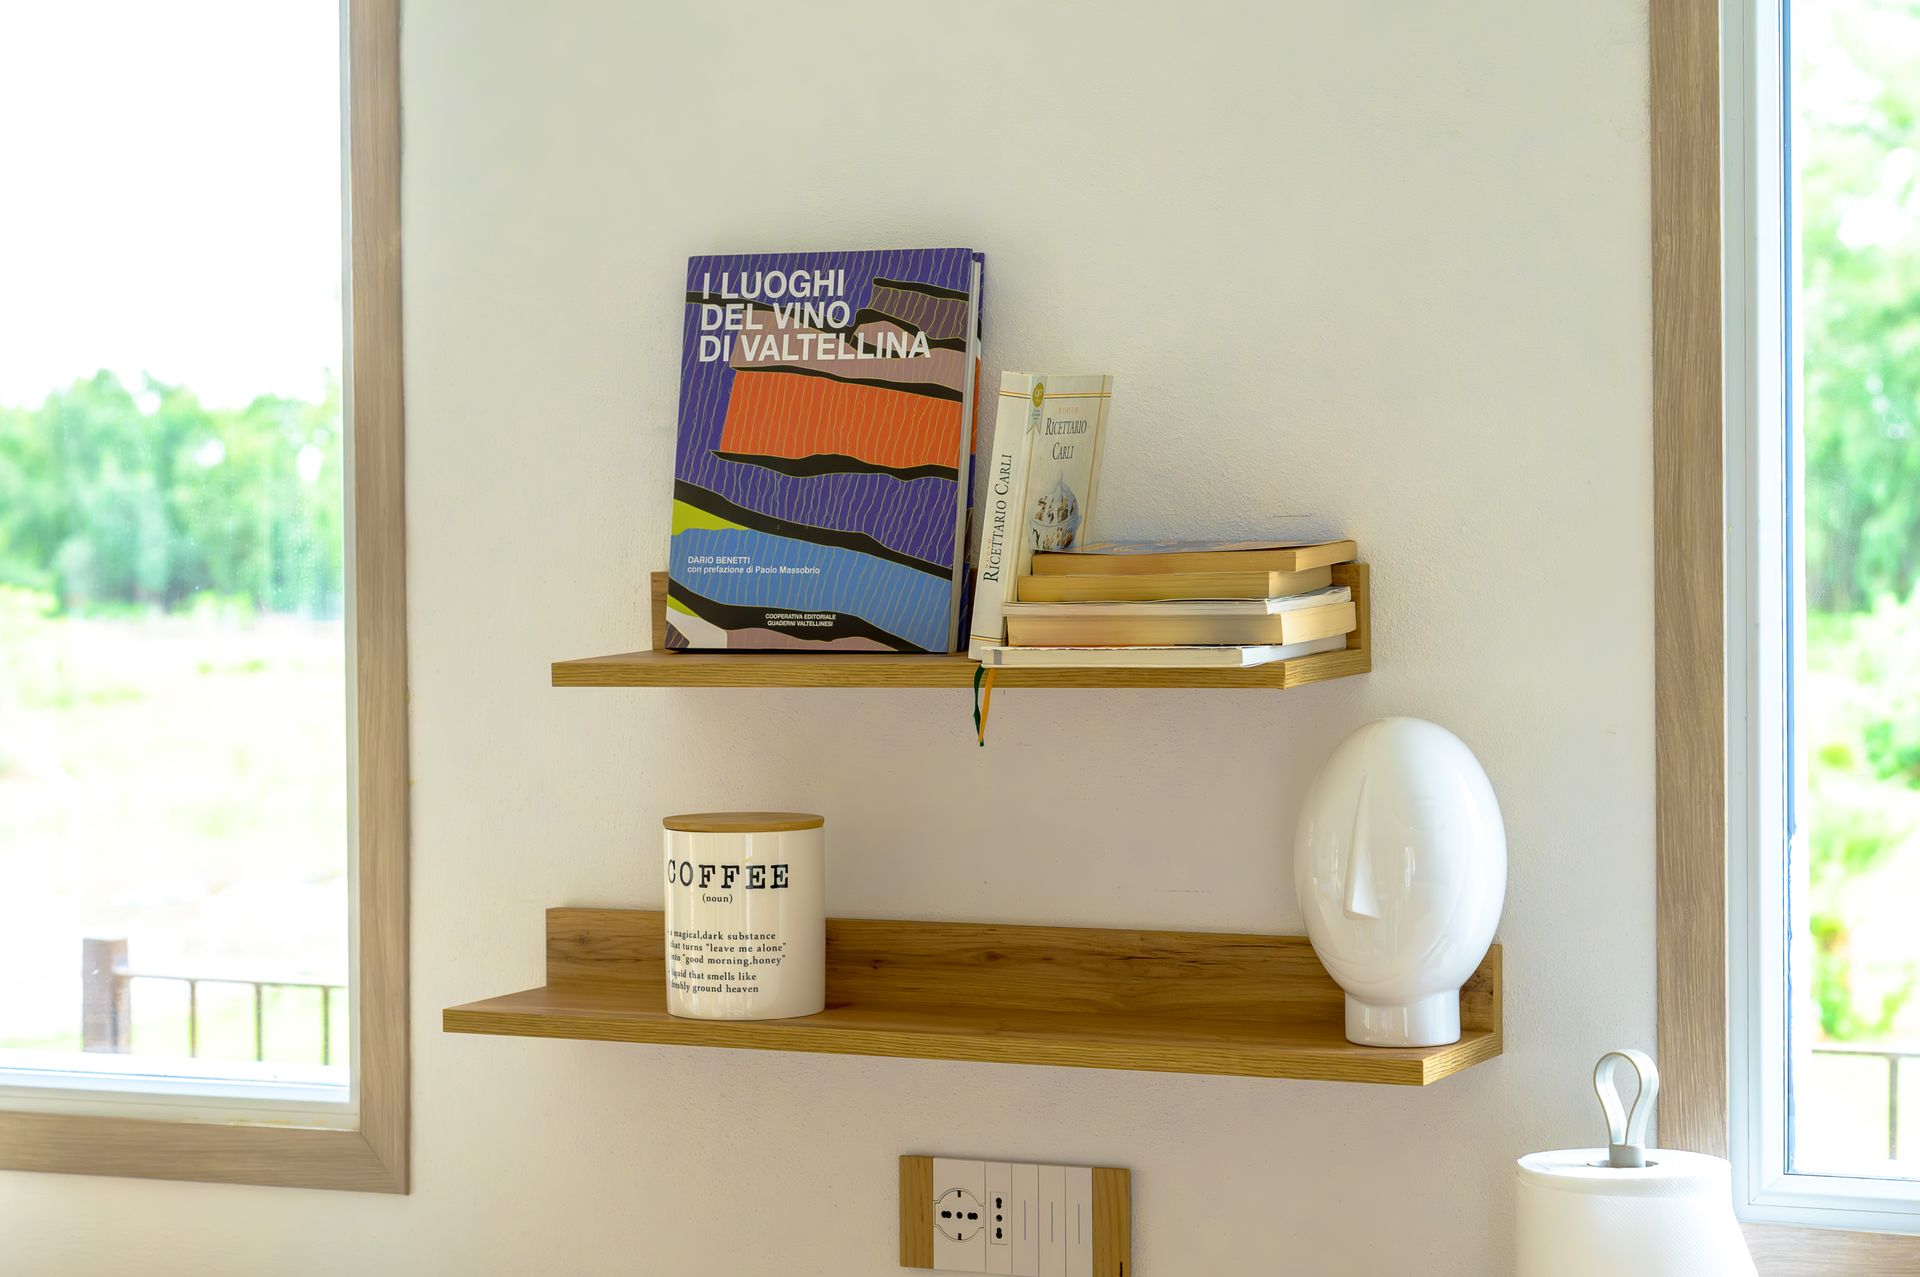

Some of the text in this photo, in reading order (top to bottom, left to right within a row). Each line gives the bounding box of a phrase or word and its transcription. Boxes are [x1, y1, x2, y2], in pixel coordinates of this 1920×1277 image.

[703, 269, 845, 300] I LUOGHI
[701, 300, 851, 331] DEL VINO
[699, 330, 932, 362] DI VALTELLINA
[983, 453, 1013, 584] RICETTARIO CARLI
[687, 555, 751, 565] DARIO BENETTI
[687, 565, 821, 575] con prefazione di Paolo Massobrio
[667, 858, 789, 890] COFFEE
[702, 893, 734, 904] (noun)
[727, 931, 776, 941] substance
[682, 943, 703, 952] turns
[688, 970, 705, 980] that
[706, 972, 735, 981] smells
[738, 972, 757, 981] like
[692, 984, 723, 993] ground
[725, 984, 759, 993] heaven
